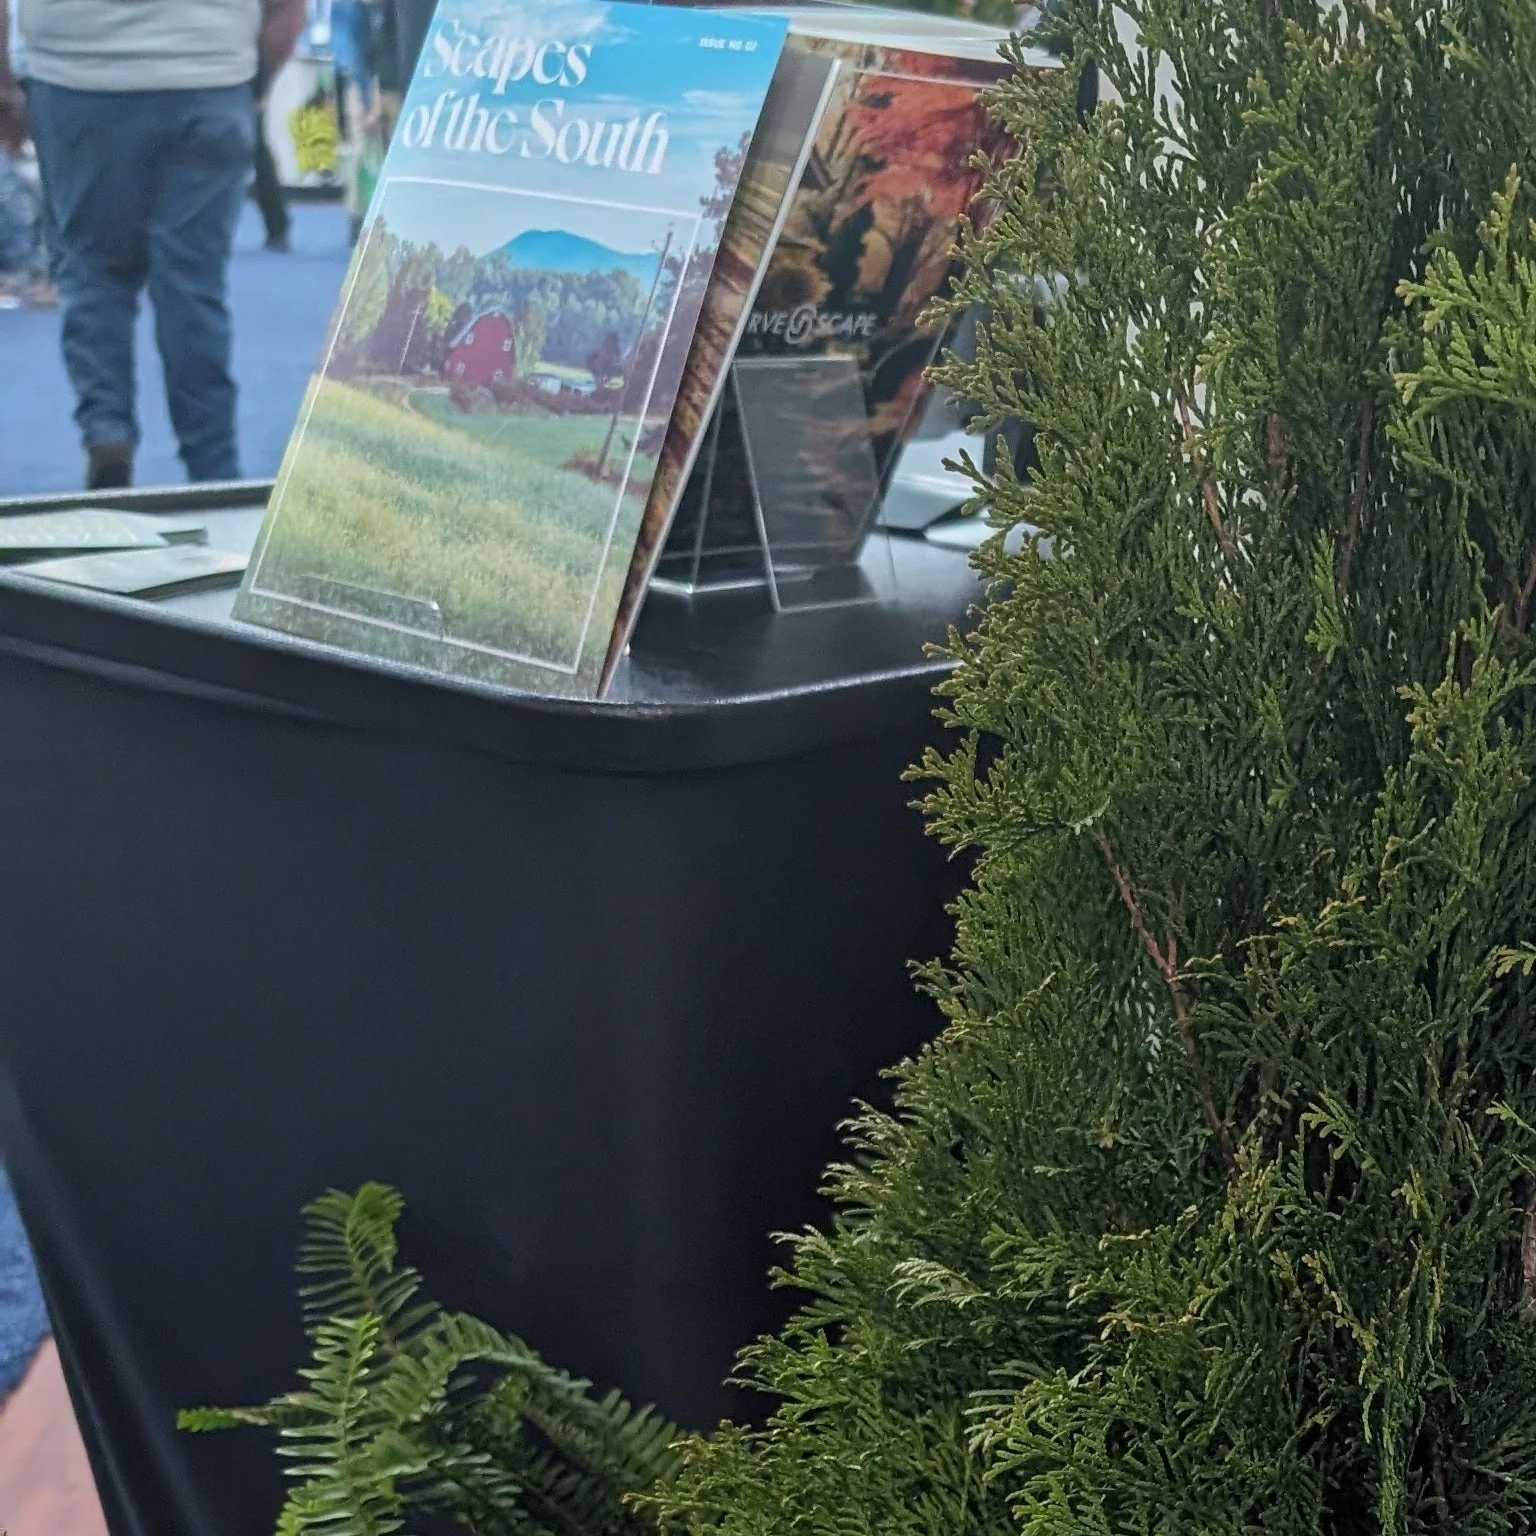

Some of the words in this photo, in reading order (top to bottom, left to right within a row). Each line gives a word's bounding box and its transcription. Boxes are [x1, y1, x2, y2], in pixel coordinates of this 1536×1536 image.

[424, 20, 592, 95] Scapes
[403, 90, 456, 149] of
[444, 92, 518, 155] the
[520, 99, 670, 174] South
